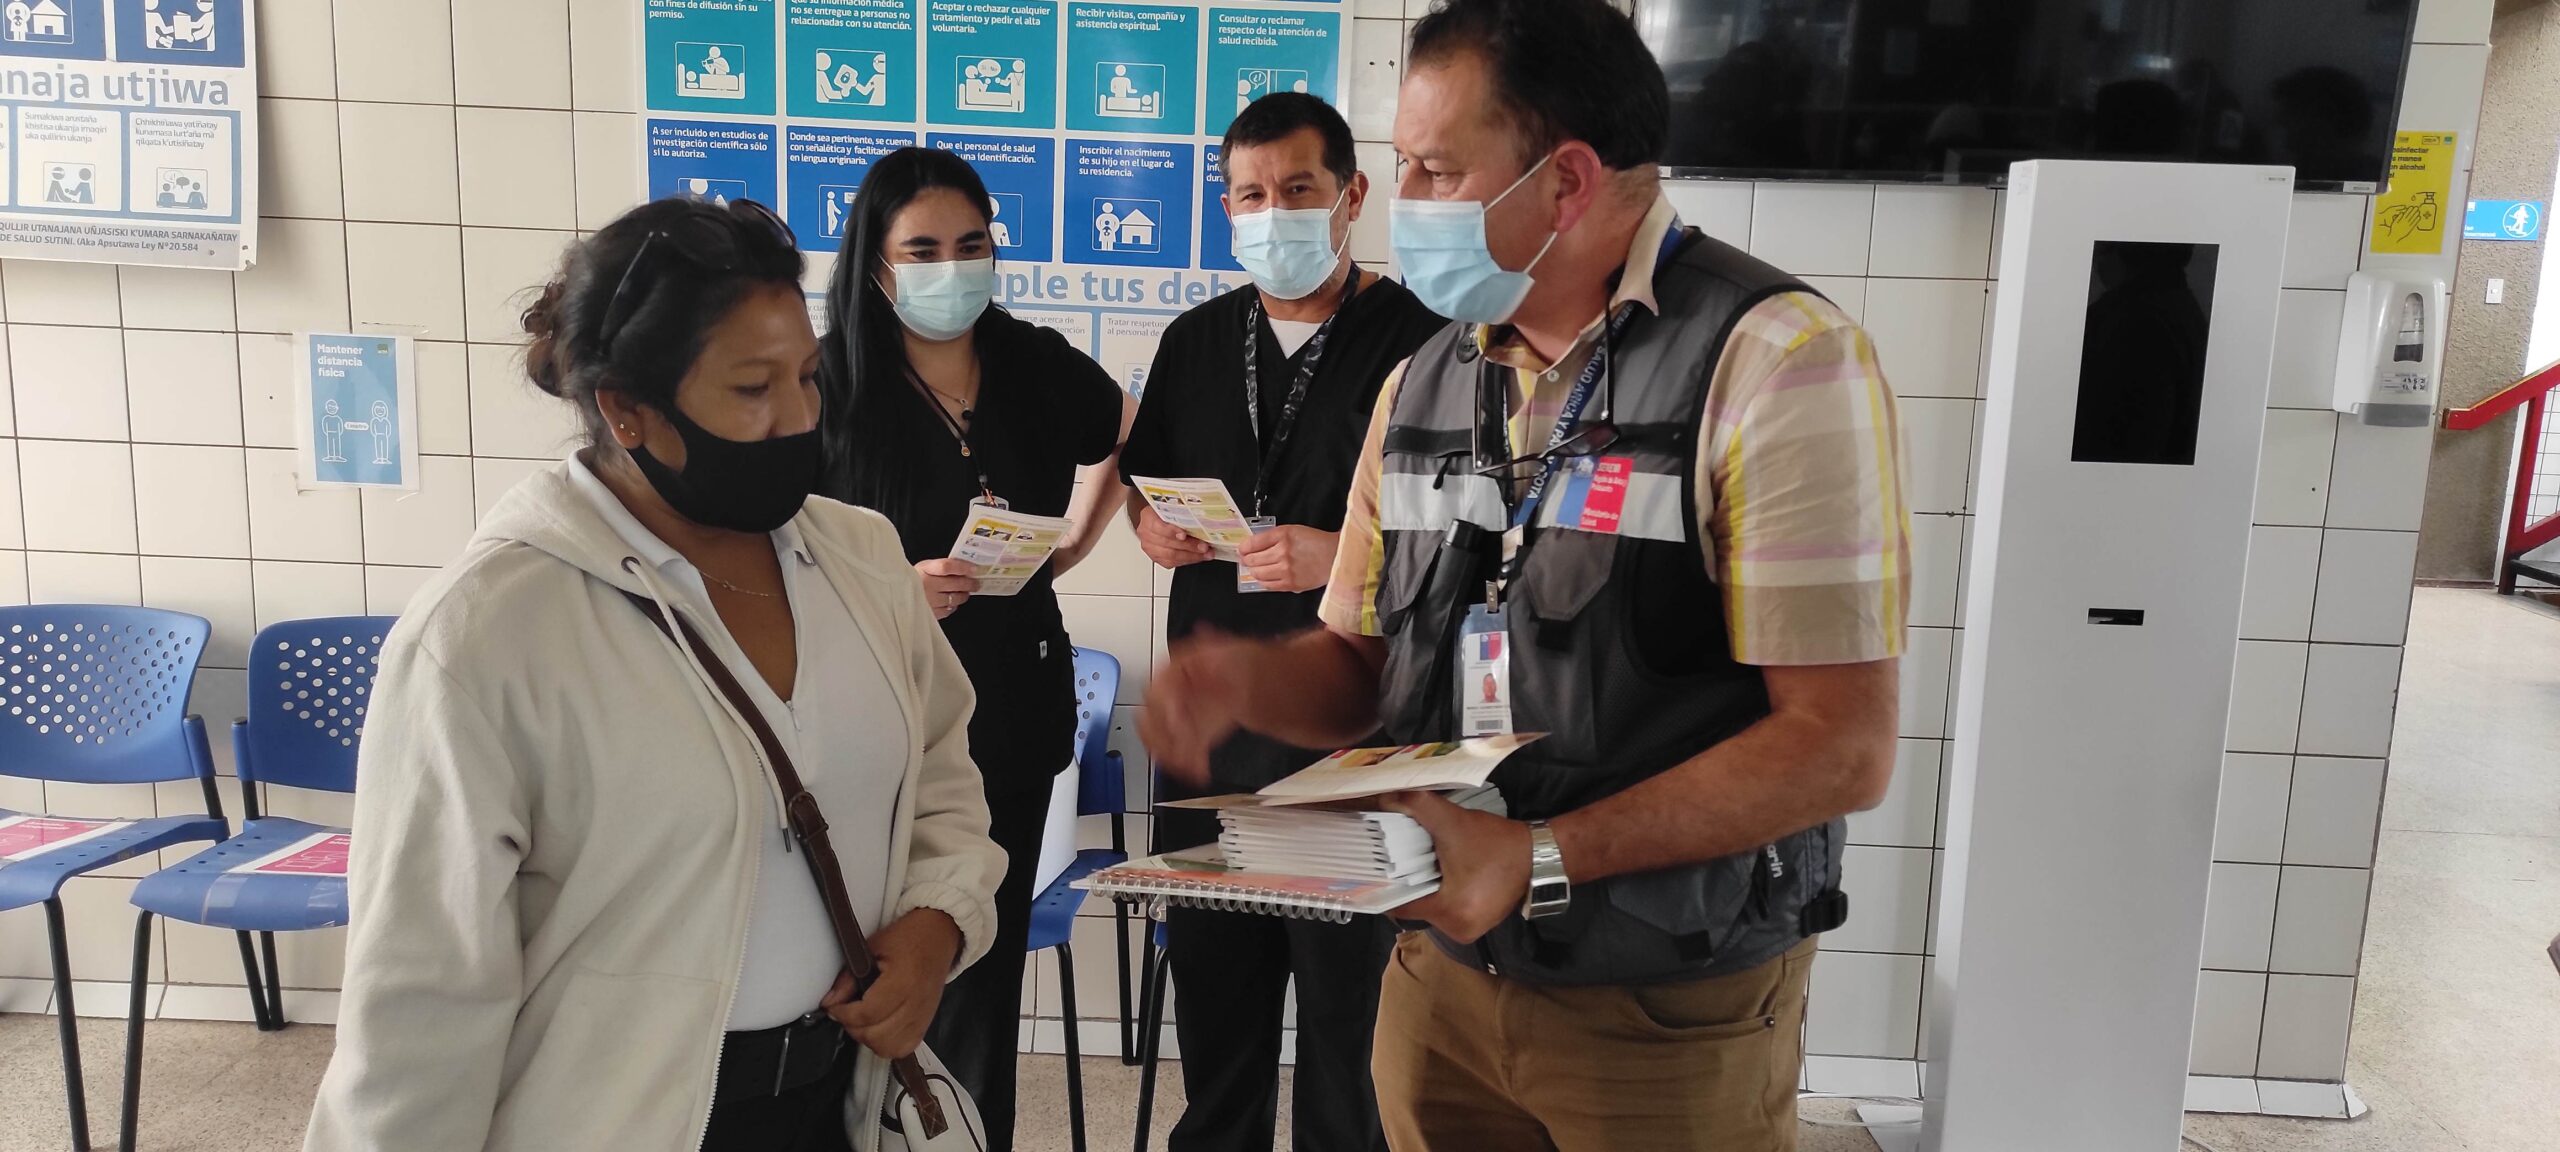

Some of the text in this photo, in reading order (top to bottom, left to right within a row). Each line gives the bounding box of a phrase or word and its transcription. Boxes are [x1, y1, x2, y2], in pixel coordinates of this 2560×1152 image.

[687, 0, 698, 9] de
[734, 2, 747, 11] sin
[748, 4, 758, 12] su
[932, 2, 965, 12] Aceptar
[974, 4, 1010, 14] rechazar
[1011, 6, 1051, 16] cualquier
[649, 10, 685, 19] permiso.
[803, 7, 812, 15] se
[814, 8, 852, 18] entregue
[860, 10, 897, 19] personas
[899, 12, 910, 20] no
[932, 13, 1041, 26] tratamiento y pedir el alta
[1076, 8, 1186, 23] Recibir visitas, compañía y
[1219, 14, 1305, 25] Consultar o reclamar
[791, 17, 912, 30] relacionadas con su atención.
[932, 24, 977, 34] voluntaria.
[1075, 19, 1161, 32] asistencia espiritual.
[1218, 26, 1327, 37] respecto de la atención de
[1218, 36, 1278, 46] salud recibida.
[0, 64, 229, 107] naja utjiwa
[652, 126, 769, 140] A ser incluido en estudios de
[790, 132, 913, 146] Donde sea pertinente, se cuente
[709, 140, 749, 150] científica
[750, 142, 767, 151] sólo
[790, 143, 897, 156] con señalética y facilitado
[937, 140, 1036, 153] Que el personal de salud
[662, 148, 670, 156] lo
[671, 149, 707, 158] autoriza.
[961, 153, 976, 161] una
[1079, 146, 1171, 158] Inscribir el nacimiento
[1207, 152, 1219, 163] Qu
[790, 154, 868, 166] en lengua originaria.
[1079, 156, 1090, 165] de
[1102, 158, 1118, 167] hijo
[1131, 159, 1140, 167] el
[1141, 160, 1162, 169] lugar
[1164, 160, 1174, 169] de
[1090, 168, 1134, 178] residencia.
[1206, 175, 1224, 183] dura
[13, 234, 42, 243] SALUD
[141, 242, 156, 251] Ley
[993, 265, 1069, 306] ple
[1081, 271, 1145, 303] tus
[1107, 318, 1170, 329] Tratar respetuos
[1056, 326, 1085, 335] tención
[1107, 327, 1160, 338] al personal de
[317, 343, 363, 355] Mantener
[317, 355, 363, 367] distancia
[1580, 345, 1606, 384] SALUD
